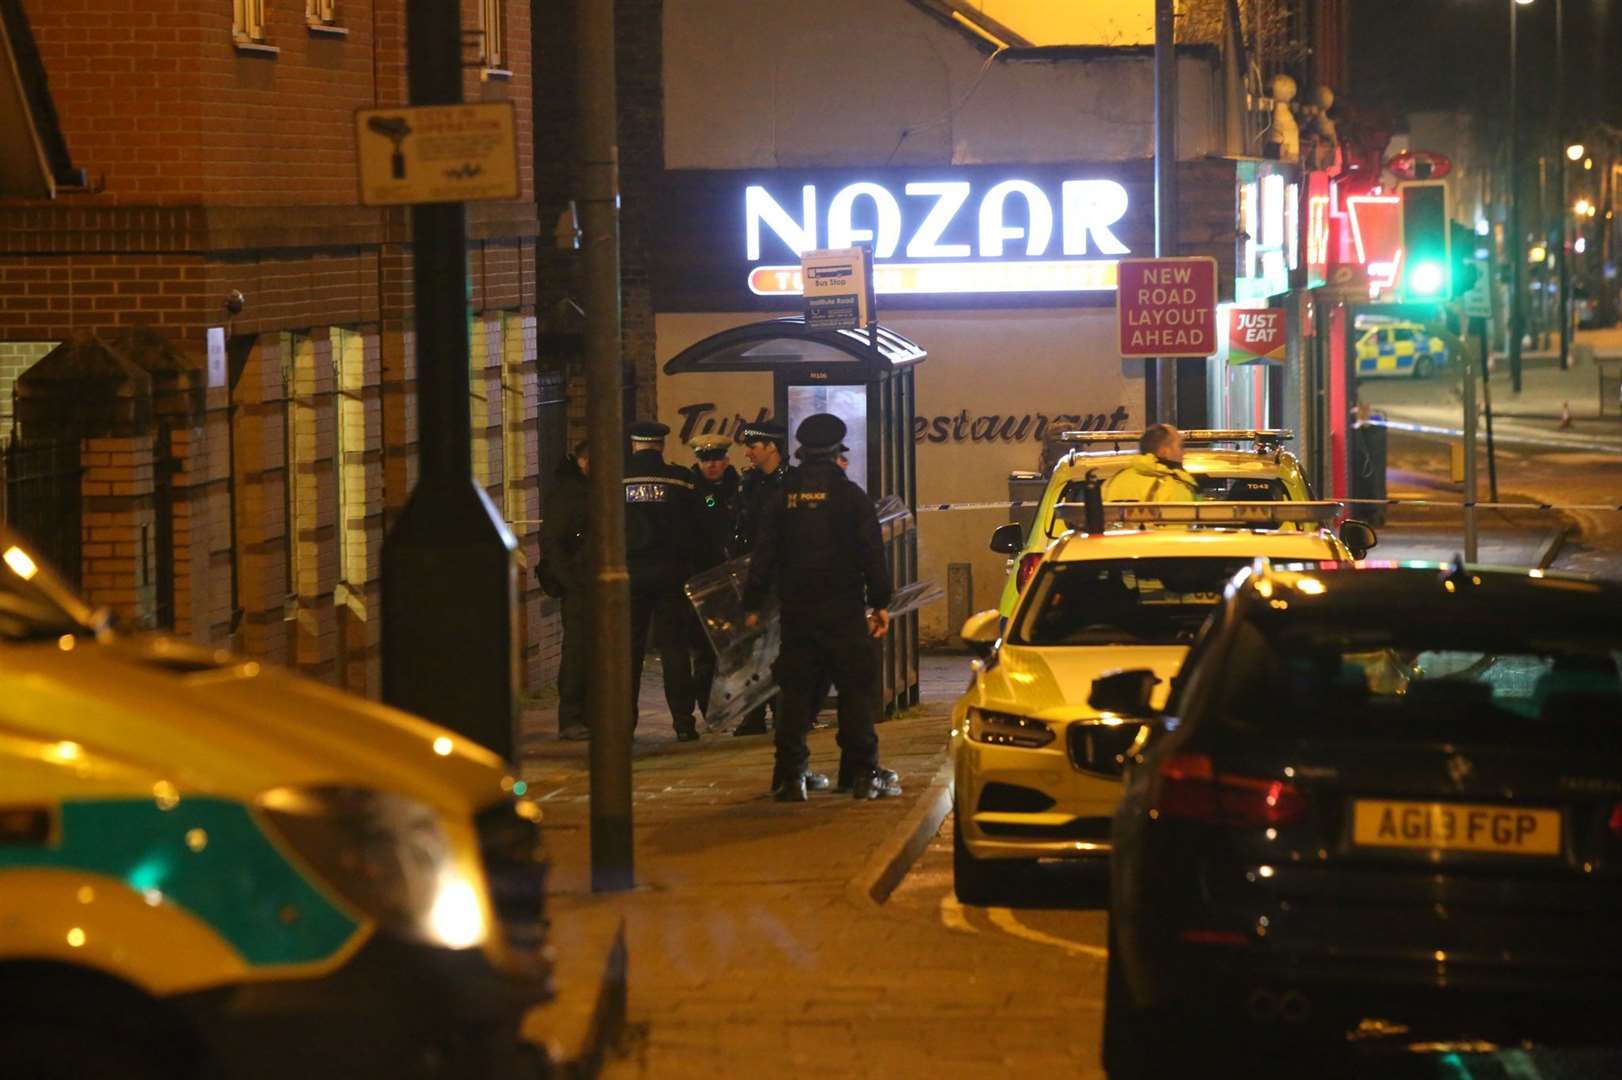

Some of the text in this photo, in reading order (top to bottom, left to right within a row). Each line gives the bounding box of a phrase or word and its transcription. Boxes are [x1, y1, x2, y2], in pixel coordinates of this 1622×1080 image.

[746, 180, 1131, 260] NAZAR
[1143, 268, 1192, 285] NEW
[1138, 288, 1197, 305] ROAD
[1128, 308, 1209, 326] LAYOUT
[1236, 314, 1278, 331] JUST
[1130, 329, 1204, 346] AHEAD
[1245, 328, 1278, 342] EAT
[1466, 810, 1538, 846] FGP
